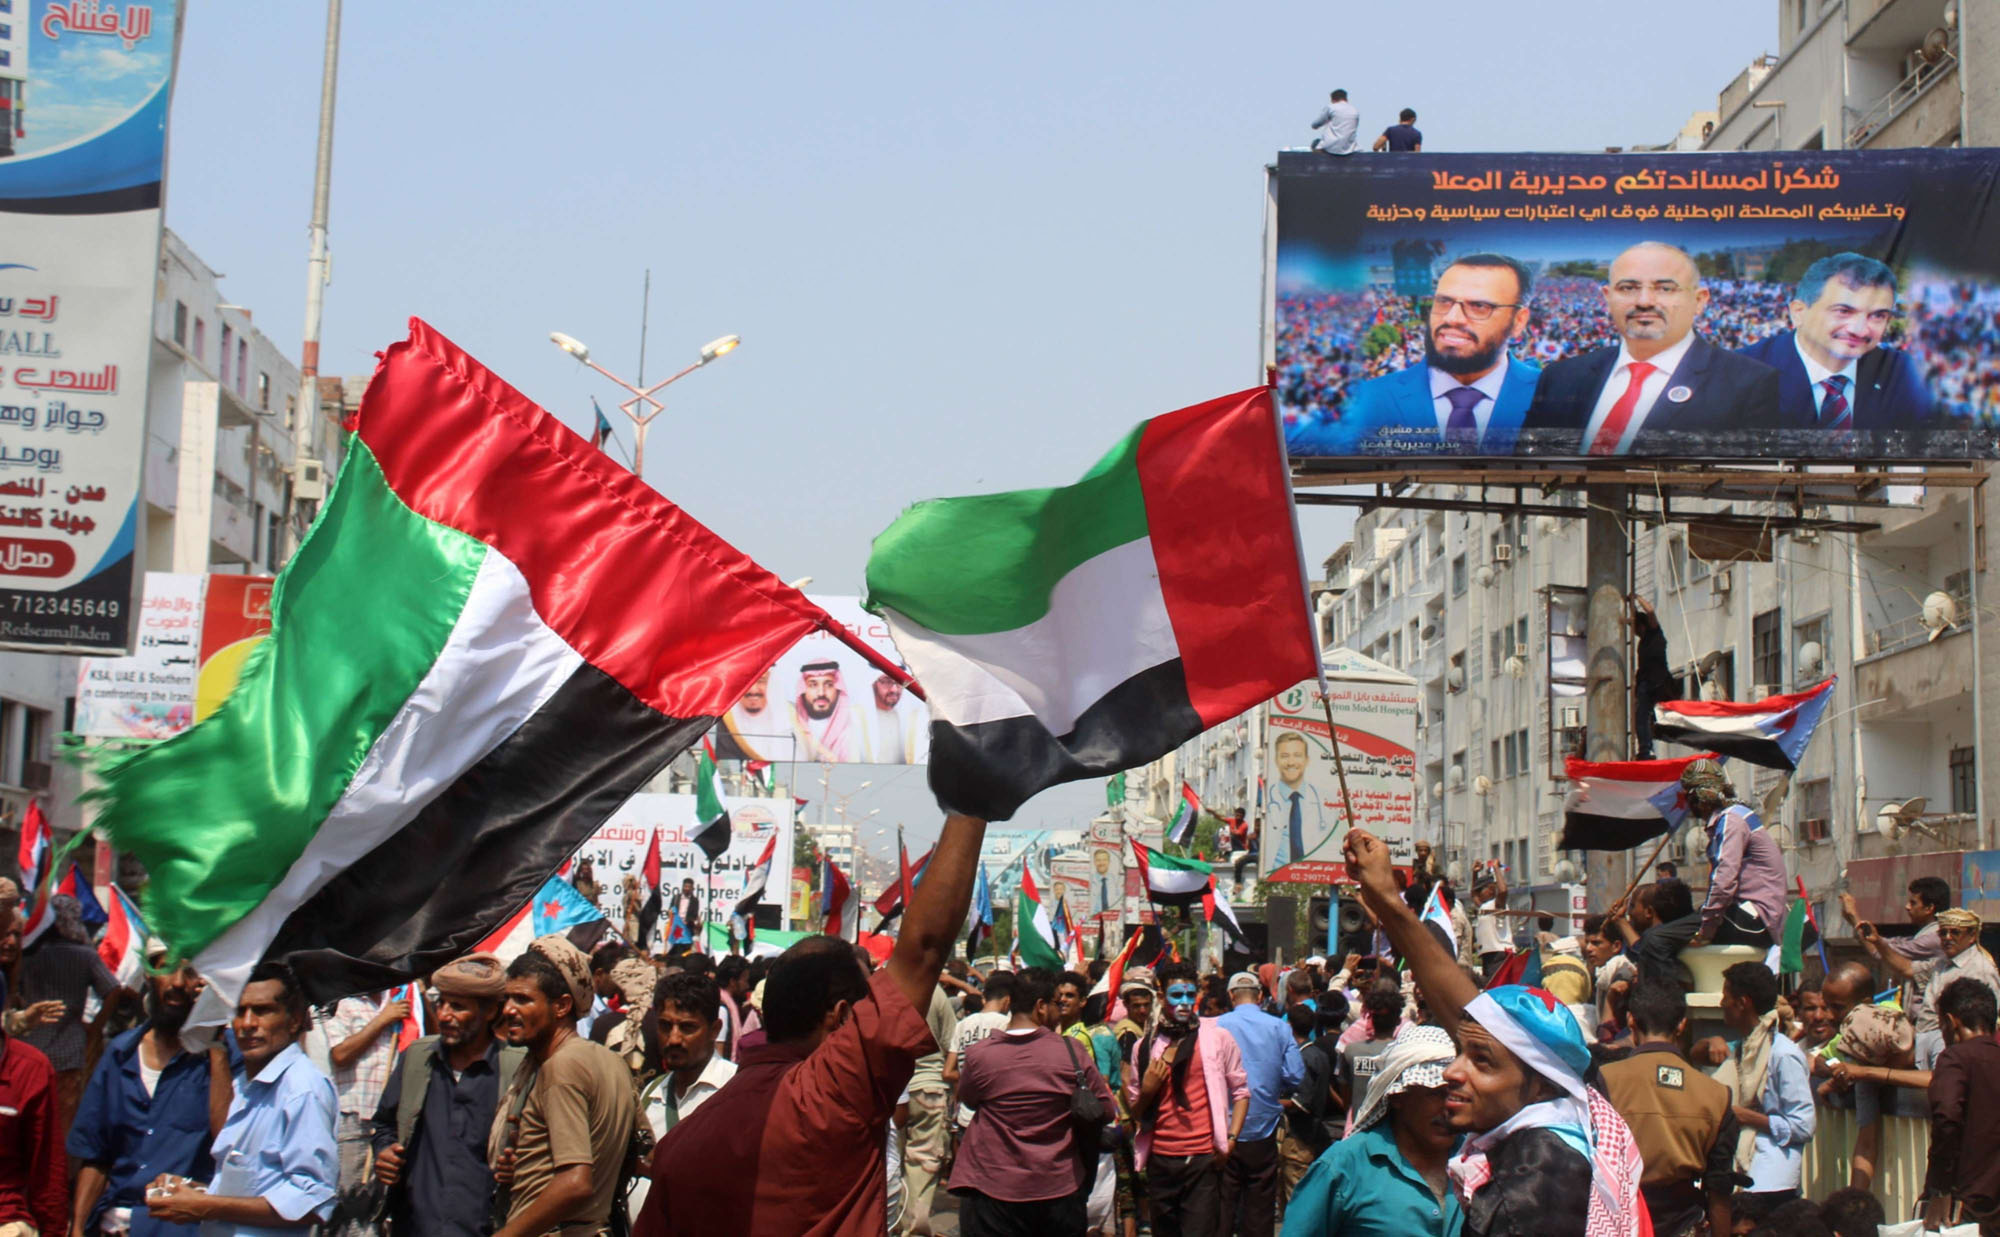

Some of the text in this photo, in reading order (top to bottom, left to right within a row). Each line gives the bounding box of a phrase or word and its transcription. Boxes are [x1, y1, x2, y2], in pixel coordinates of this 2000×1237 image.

[1432, 171, 1502, 191] المعلا
[1509, 171, 1608, 195] مديرية
[1614, 166, 1767, 194] لمساندتكم
[1366, 203, 1426, 222] وحزبية
[1430, 204, 1500, 222] سياسية
[1504, 204, 1575, 222] اعتبارات
[1611, 204, 1659, 221] فوق
[1663, 205, 1734, 221] الوطنية
[1738, 204, 1813, 218] المصلحة
[13, 364, 118, 396] السحب
[66, 485, 107, 505] عدن
[11, 595, 119, 617] 712345649
